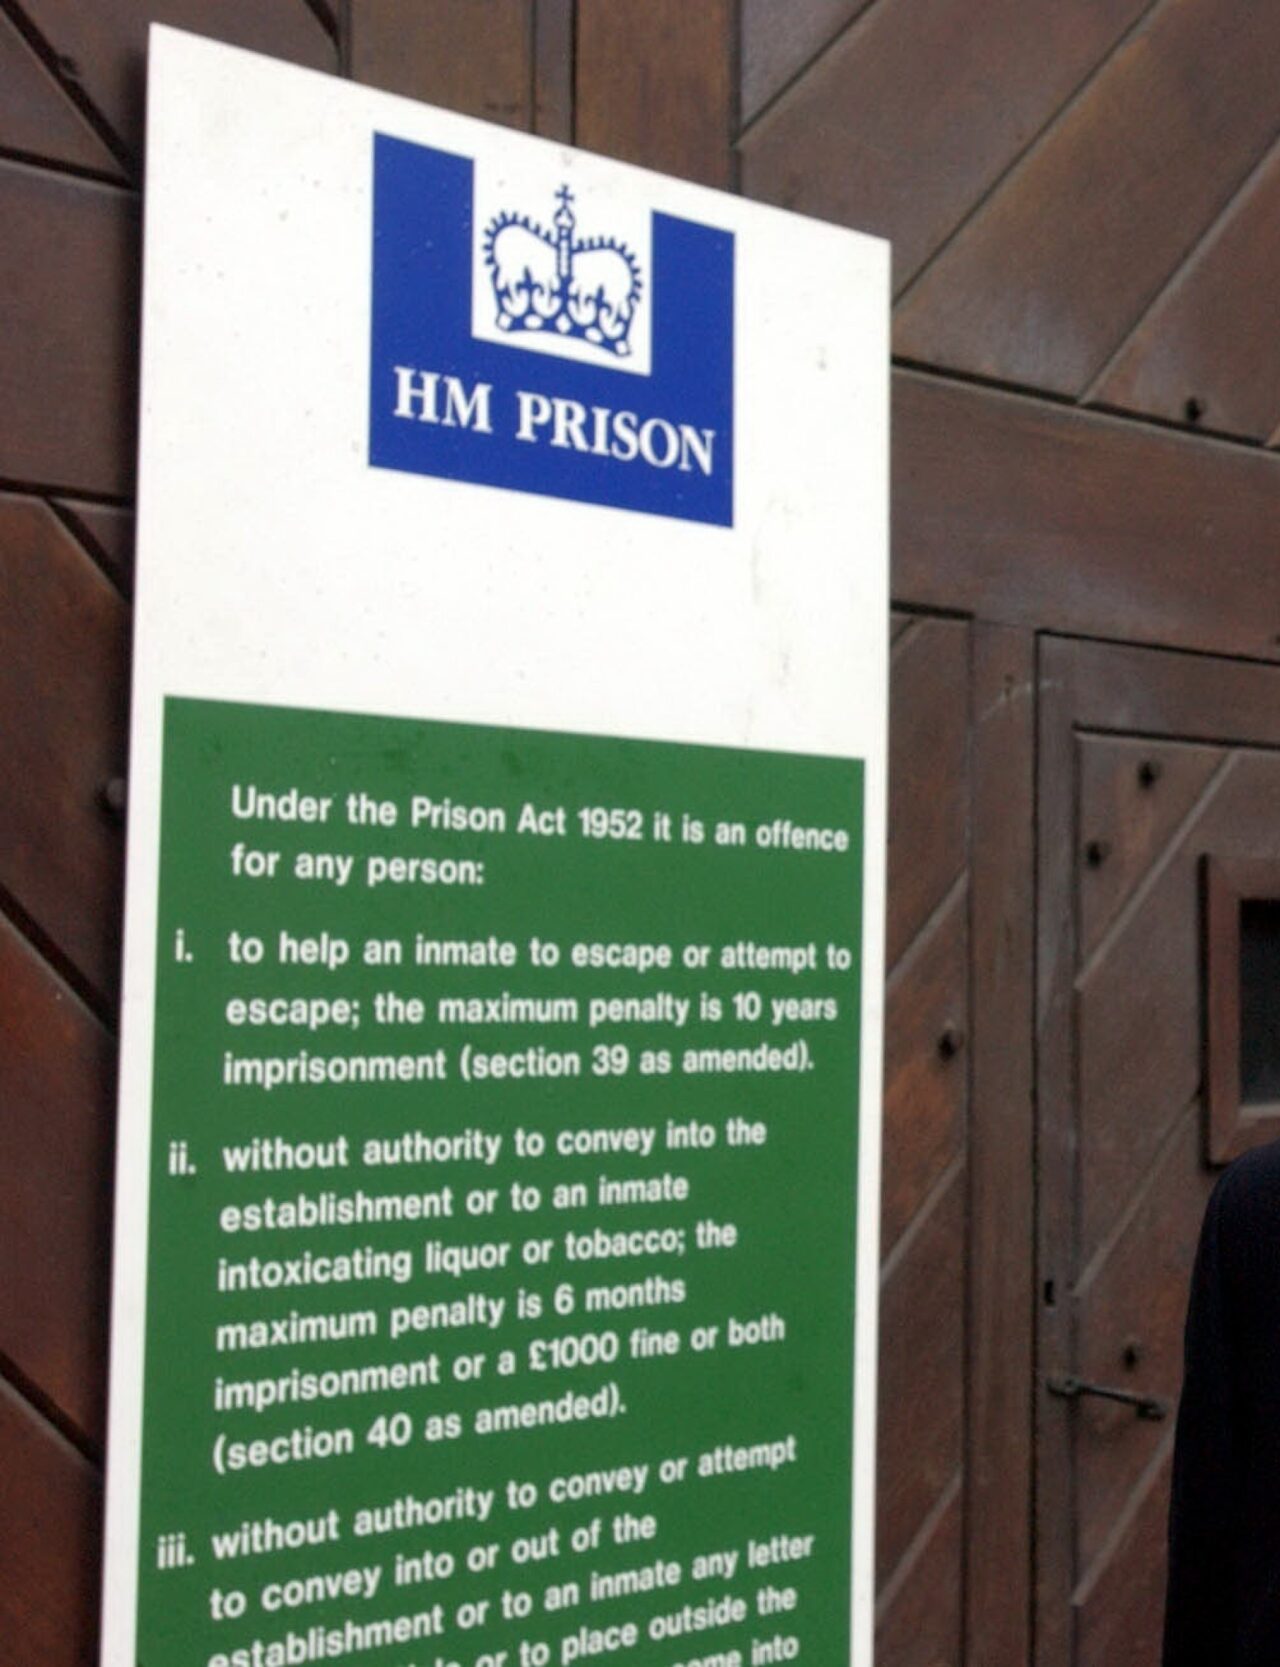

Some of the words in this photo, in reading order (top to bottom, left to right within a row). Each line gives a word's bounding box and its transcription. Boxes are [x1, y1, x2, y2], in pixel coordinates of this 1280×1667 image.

[394, 366, 492, 433] HM
[515, 391, 715, 475] PRISON
[231, 784, 333, 823] Under
[346, 792, 398, 827] the
[411, 795, 506, 833] Prison
[516, 803, 566, 836] Act
[577, 807, 644, 840] 1952
[653, 811, 671, 842] it
[682, 813, 705, 844] is
[714, 822, 746, 845] an
[755, 819, 850, 852] offence
[230, 842, 281, 877] for
[294, 852, 354, 886] any
[367, 856, 484, 887] person:
[175, 928, 193, 962] i.
[227, 931, 265, 964] to
[278, 930, 350, 971] help
[363, 939, 402, 965] an
[415, 933, 517, 967] inmate
[529, 937, 560, 967] to
[571, 942, 673, 973] escape
[682, 944, 711, 969] or
[720, 941, 817, 975] attempt
[826, 944, 852, 970] to
[225, 998, 360, 1031] escape;
[373, 991, 425, 1024] the
[438, 991, 579, 1024] maximum
[589, 992, 690, 1028] penalty
[700, 992, 723, 1022] is
[732, 991, 762, 1021] 10
[771, 998, 838, 1026] years
[223, 1049, 447, 1091] imprisonment
[460, 1044, 581, 1081] (section
[591, 1044, 630, 1076] 39
[639, 1050, 672, 1074] as
[682, 1039, 814, 1074] amended).
[168, 1141, 196, 1175] ii.
[222, 1135, 349, 1172] without
[362, 1129, 502, 1166] authority
[514, 1127, 545, 1157] to
[556, 1127, 656, 1156] convey
[666, 1120, 716, 1149] into
[726, 1117, 767, 1146] the
[219, 1187, 453, 1233] establishment
[466, 1189, 498, 1215] or
[510, 1182, 541, 1212] to
[552, 1183, 588, 1209] an
[598, 1173, 689, 1205] inmate
[217, 1246, 413, 1292] intoxicating
[425, 1241, 511, 1277] liquor
[522, 1239, 554, 1265] or
[564, 1228, 685, 1260] tobacco;
[695, 1219, 737, 1249] the
[216, 1310, 377, 1351] maximum
[390, 1293, 505, 1339] penalty
[517, 1288, 543, 1319] is
[554, 1283, 575, 1315] 6
[585, 1275, 686, 1311] months
[214, 1354, 440, 1413] imprisonment
[452, 1354, 486, 1381] or
[497, 1350, 516, 1376] a
[529, 1331, 619, 1371] £1000
[629, 1328, 680, 1358] fine
[690, 1326, 718, 1351] or
[728, 1313, 785, 1346] both
[213, 1426, 354, 1474] (section
[366, 1412, 412, 1448] 40
[424, 1413, 462, 1441] as
[474, 1382, 626, 1434] amended).
[157, 1532, 195, 1569] iii.
[211, 1509, 340, 1560] without
[353, 1487, 494, 1536] authority
[506, 1480, 538, 1509] to
[548, 1465, 649, 1503] convey
[659, 1457, 688, 1483] or
[697, 1435, 796, 1477] attempt
[209, 1589, 247, 1621] to
[261, 1566, 382, 1611] convey
[395, 1550, 455, 1585] into
[467, 1544, 500, 1572] or
[511, 1528, 559, 1564] out
[571, 1518, 601, 1552] of
[612, 1513, 657, 1544] the
[456, 1601, 490, 1629] or
[501, 1590, 533, 1619] to
[544, 1582, 579, 1611] an
[590, 1560, 682, 1601] inmate
[691, 1551, 739, 1580] any
[748, 1535, 814, 1568] letter
[519, 1641, 550, 1667] to
[561, 1623, 638, 1666] place
[648, 1595, 747, 1640] outside
[756, 1586, 797, 1615] the
[751, 1635, 799, 1667] into
